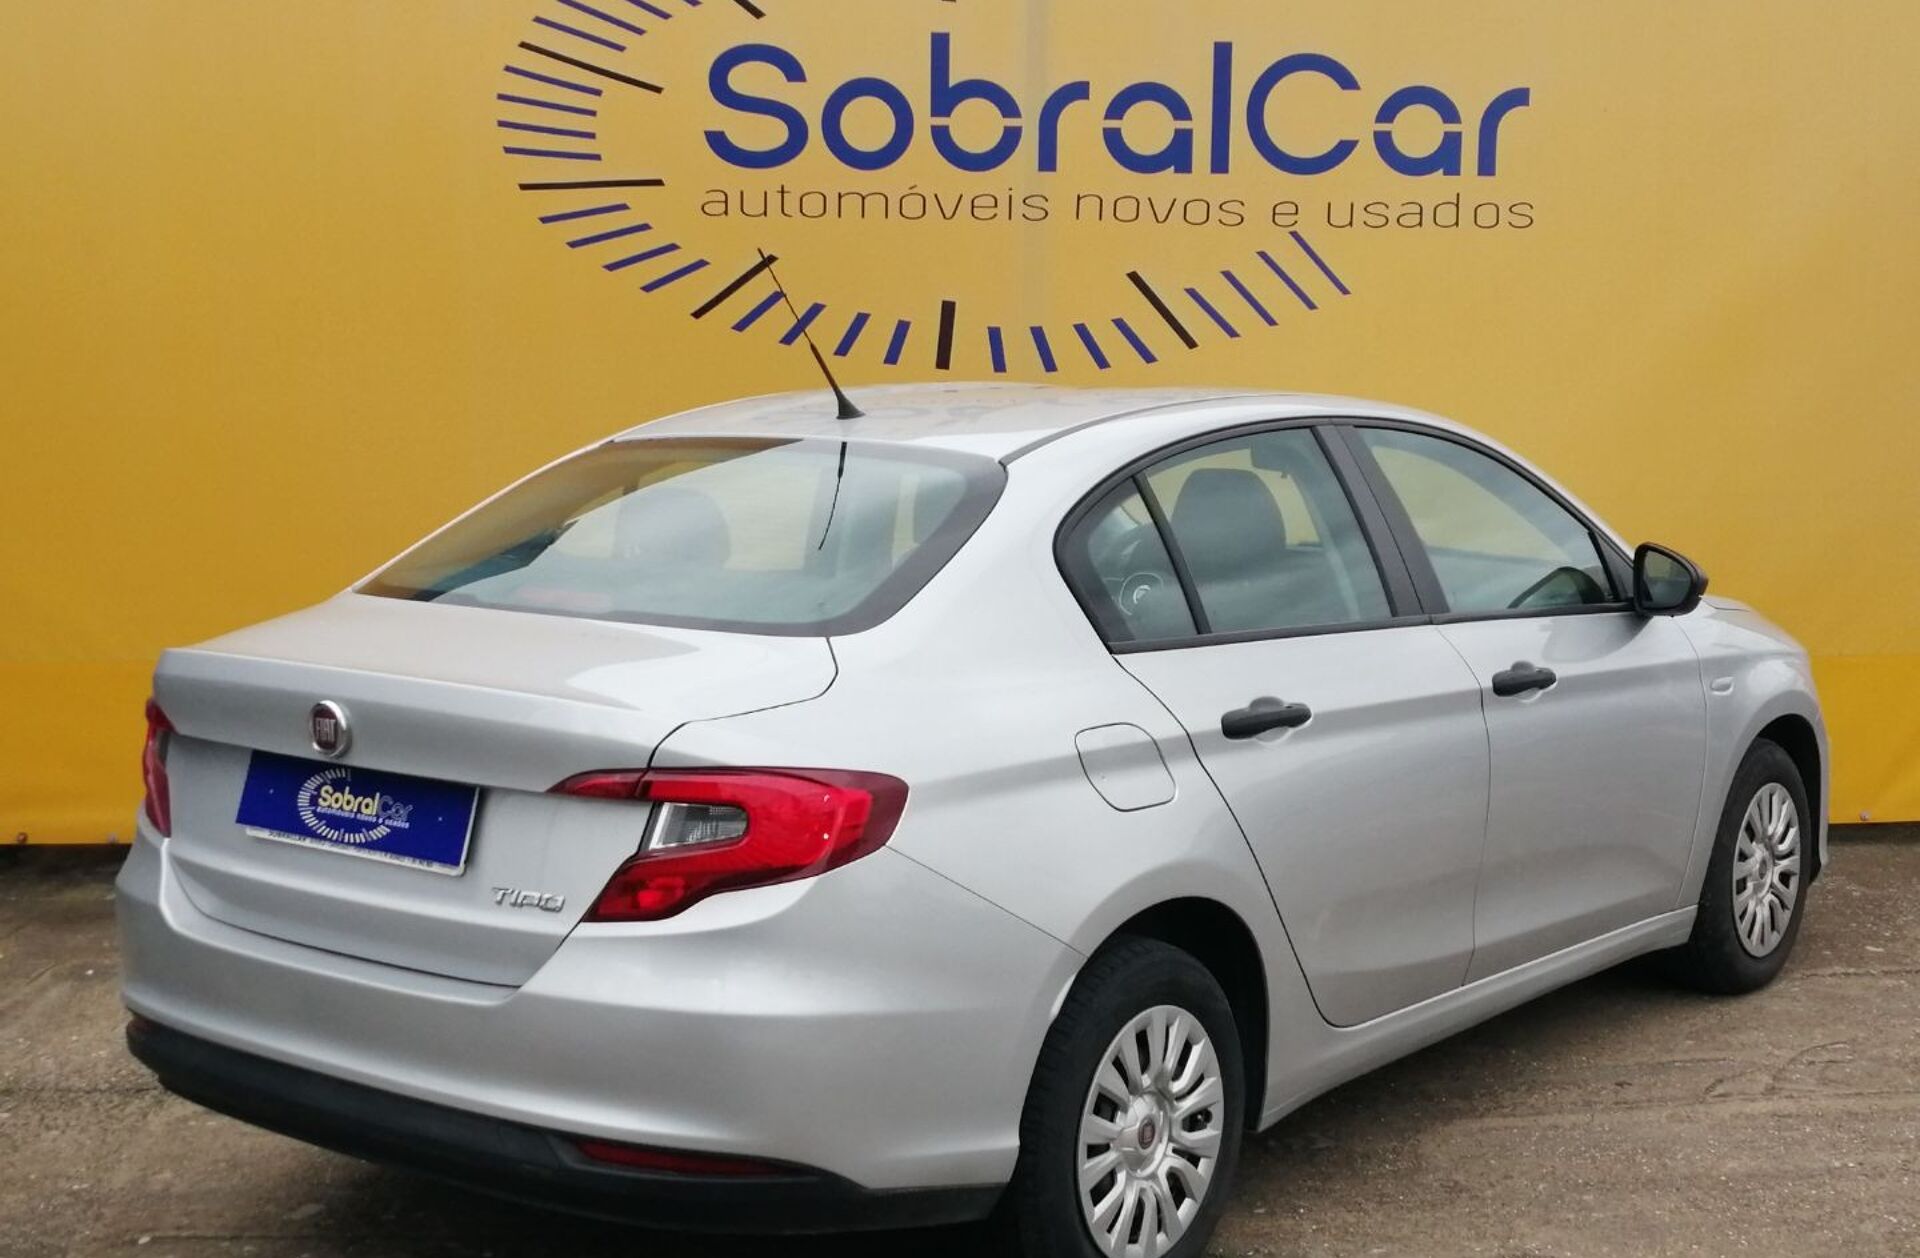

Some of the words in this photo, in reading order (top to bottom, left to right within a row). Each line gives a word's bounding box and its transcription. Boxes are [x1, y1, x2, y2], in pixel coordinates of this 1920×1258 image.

[703, 31, 1531, 177] SobralCar
[700, 184, 1050, 222] automóveis
[1075, 192, 1246, 227] novos
[1271, 201, 1300, 229] e
[1326, 191, 1535, 230] usados
[315, 717, 336, 742] FIAT
[492, 887, 565, 913] TIPO
